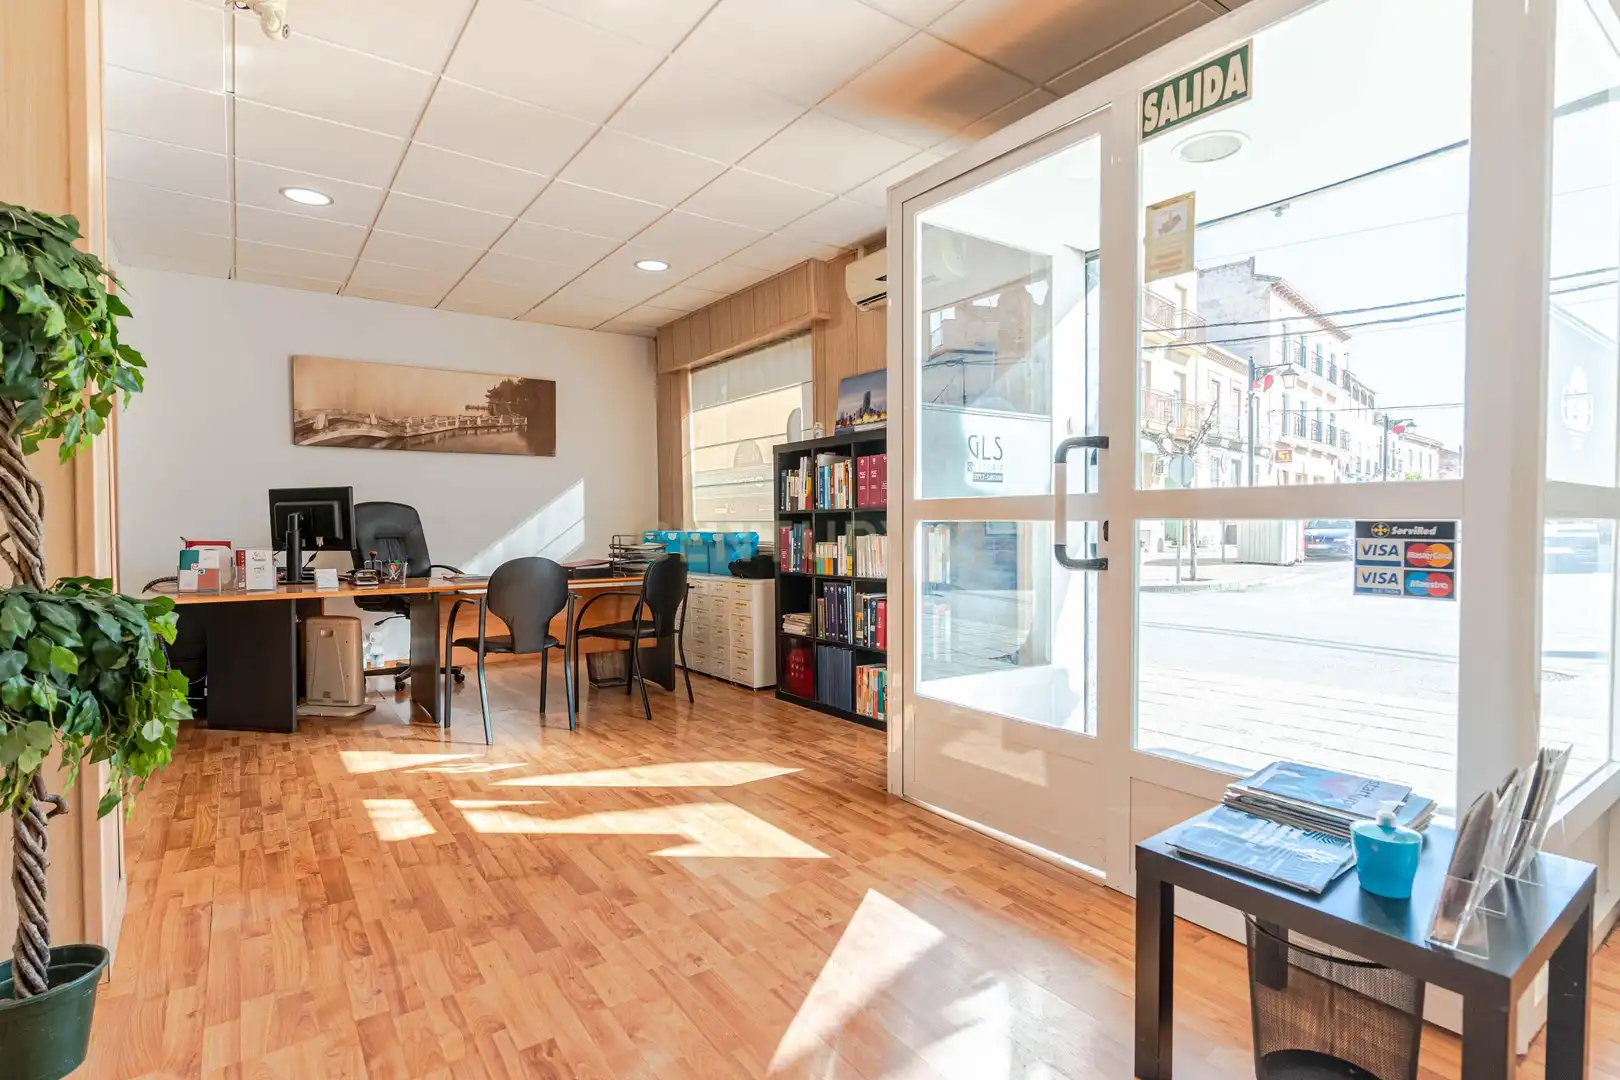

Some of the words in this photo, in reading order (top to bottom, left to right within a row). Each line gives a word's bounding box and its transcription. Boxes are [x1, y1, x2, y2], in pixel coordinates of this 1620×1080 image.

[1144, 54, 1247, 132] SALIDA
[968, 434, 1003, 461] GLS
[1391, 526, 1437, 535] ServiRed
[1361, 544, 1399, 557] VISA
[1361, 572, 1399, 585] VISA
[1410, 580, 1449, 589] Maestro
